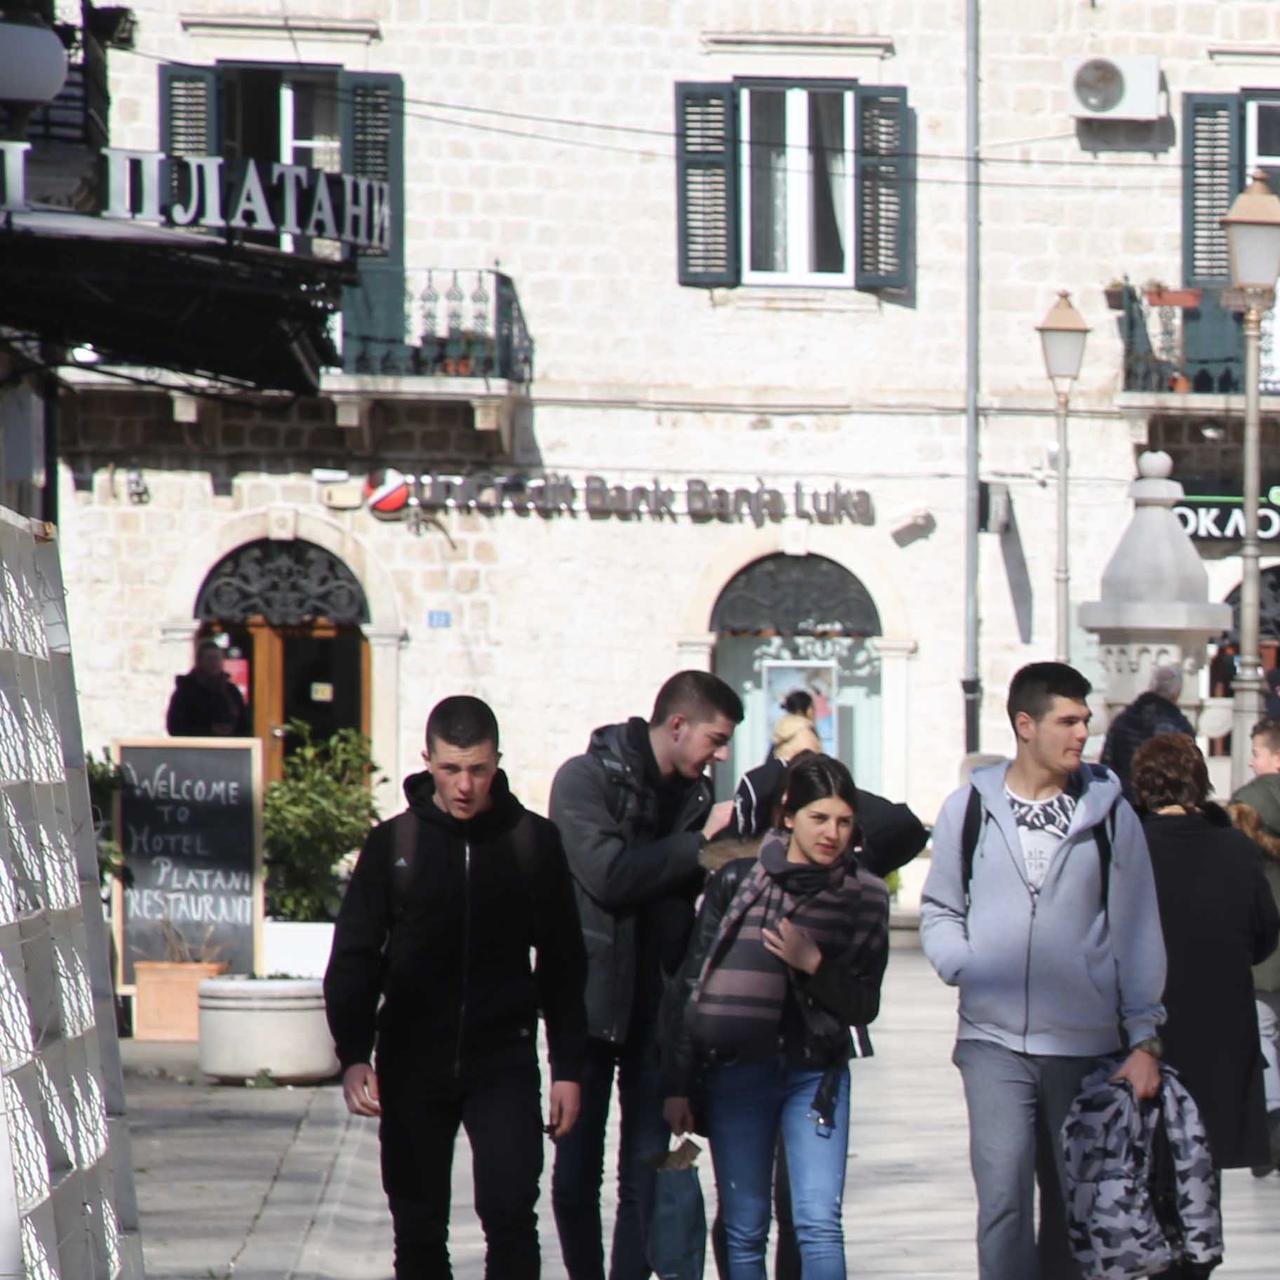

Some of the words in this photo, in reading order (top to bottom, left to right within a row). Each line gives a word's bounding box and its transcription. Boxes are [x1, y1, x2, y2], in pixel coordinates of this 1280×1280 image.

[101, 147, 391, 251] ПЛАТАНИ
[585, 476, 677, 522] Bank
[687, 477, 786, 529] Banja
[795, 480, 876, 527] Luka
[156, 806, 190, 823] TO
[129, 824, 209, 855] HOTEL
[152, 856, 250, 891] PLATANI
[126, 888, 253, 924] RESTAURANT
